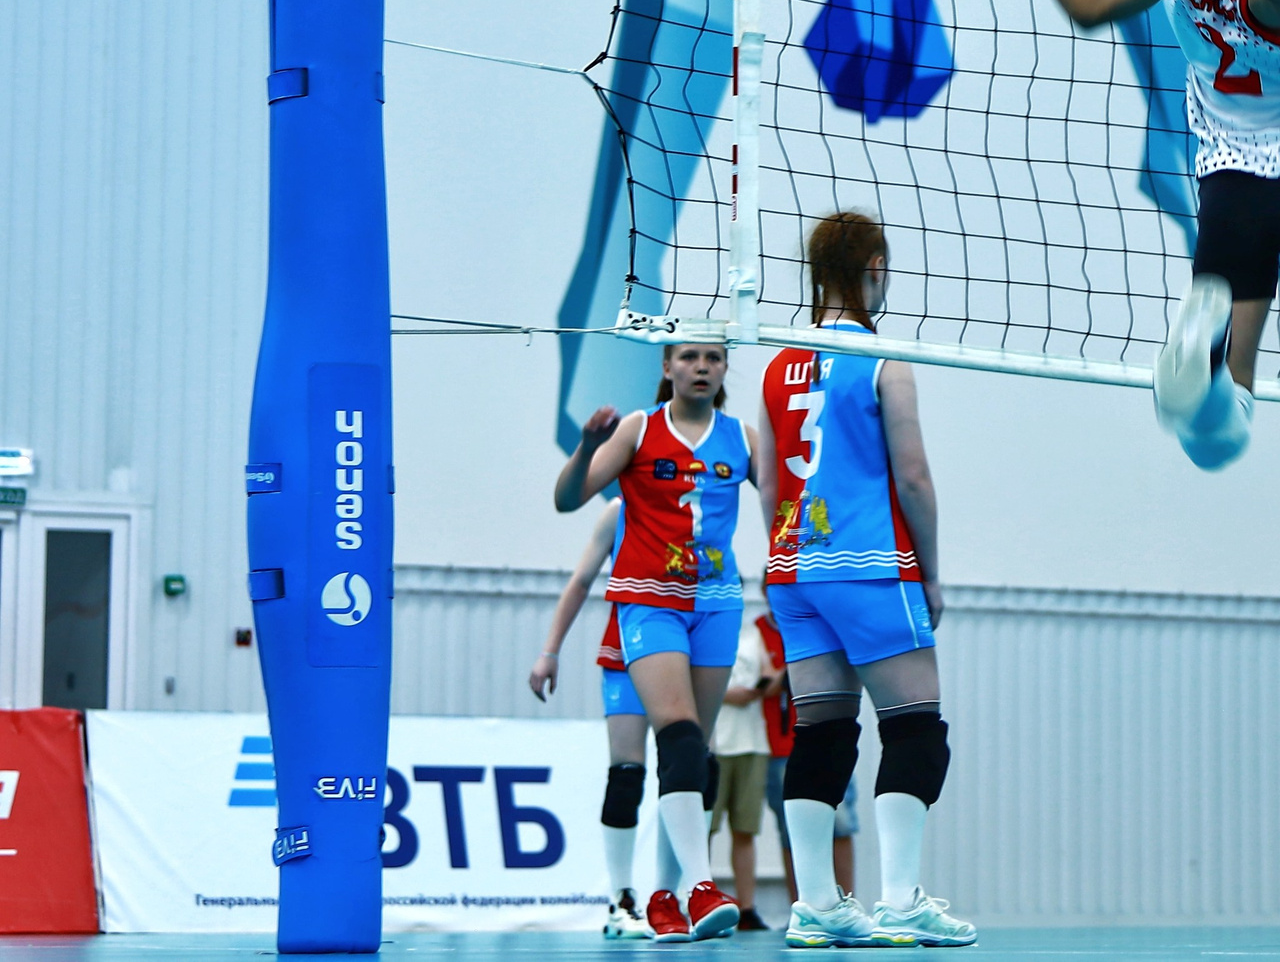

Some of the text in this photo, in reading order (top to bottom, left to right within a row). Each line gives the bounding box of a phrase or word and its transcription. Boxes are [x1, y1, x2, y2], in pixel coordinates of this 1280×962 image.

[1195, 22, 1263, 96] 2
[785, 390, 826, 480] 3
[679, 488, 703, 536] 1
